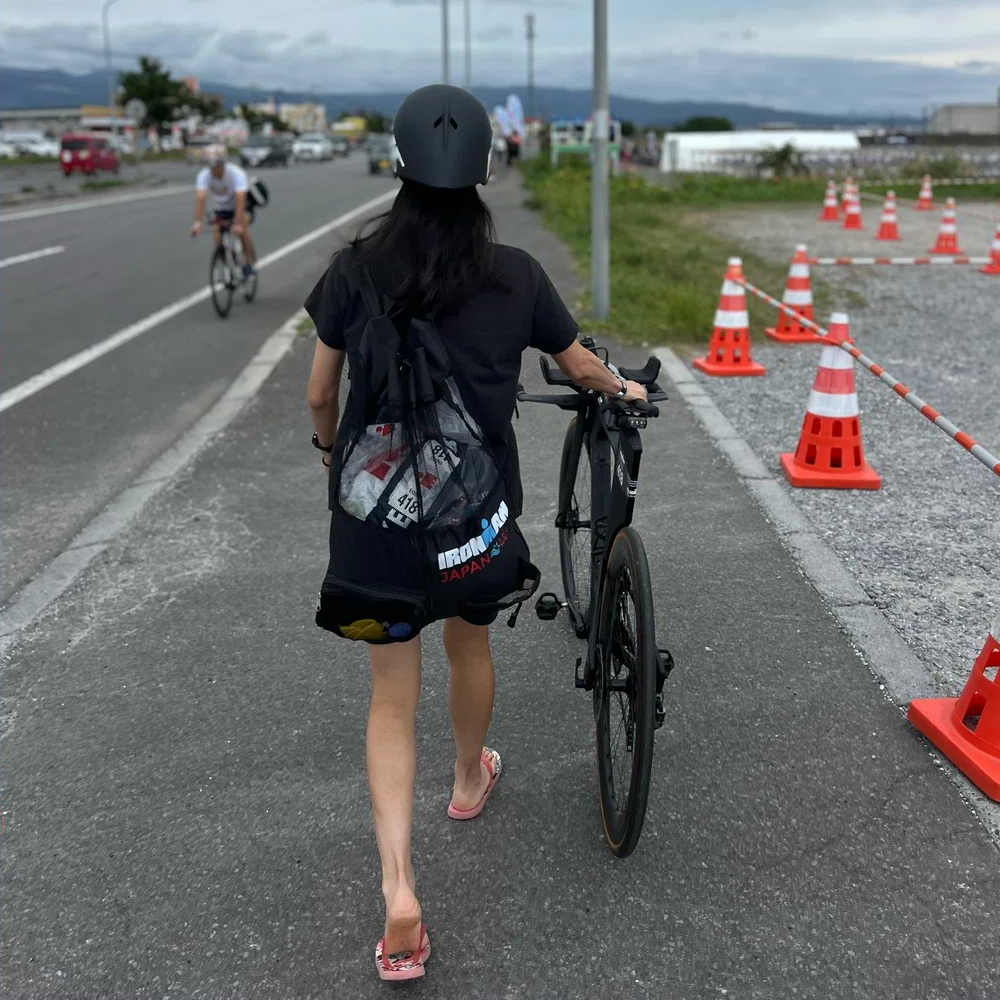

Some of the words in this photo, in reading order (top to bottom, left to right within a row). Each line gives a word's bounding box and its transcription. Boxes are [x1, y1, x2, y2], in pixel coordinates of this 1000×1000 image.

[396, 494, 420, 515] 418
[438, 500, 509, 570] IRONMAN
[441, 553, 491, 583] JAPAN
